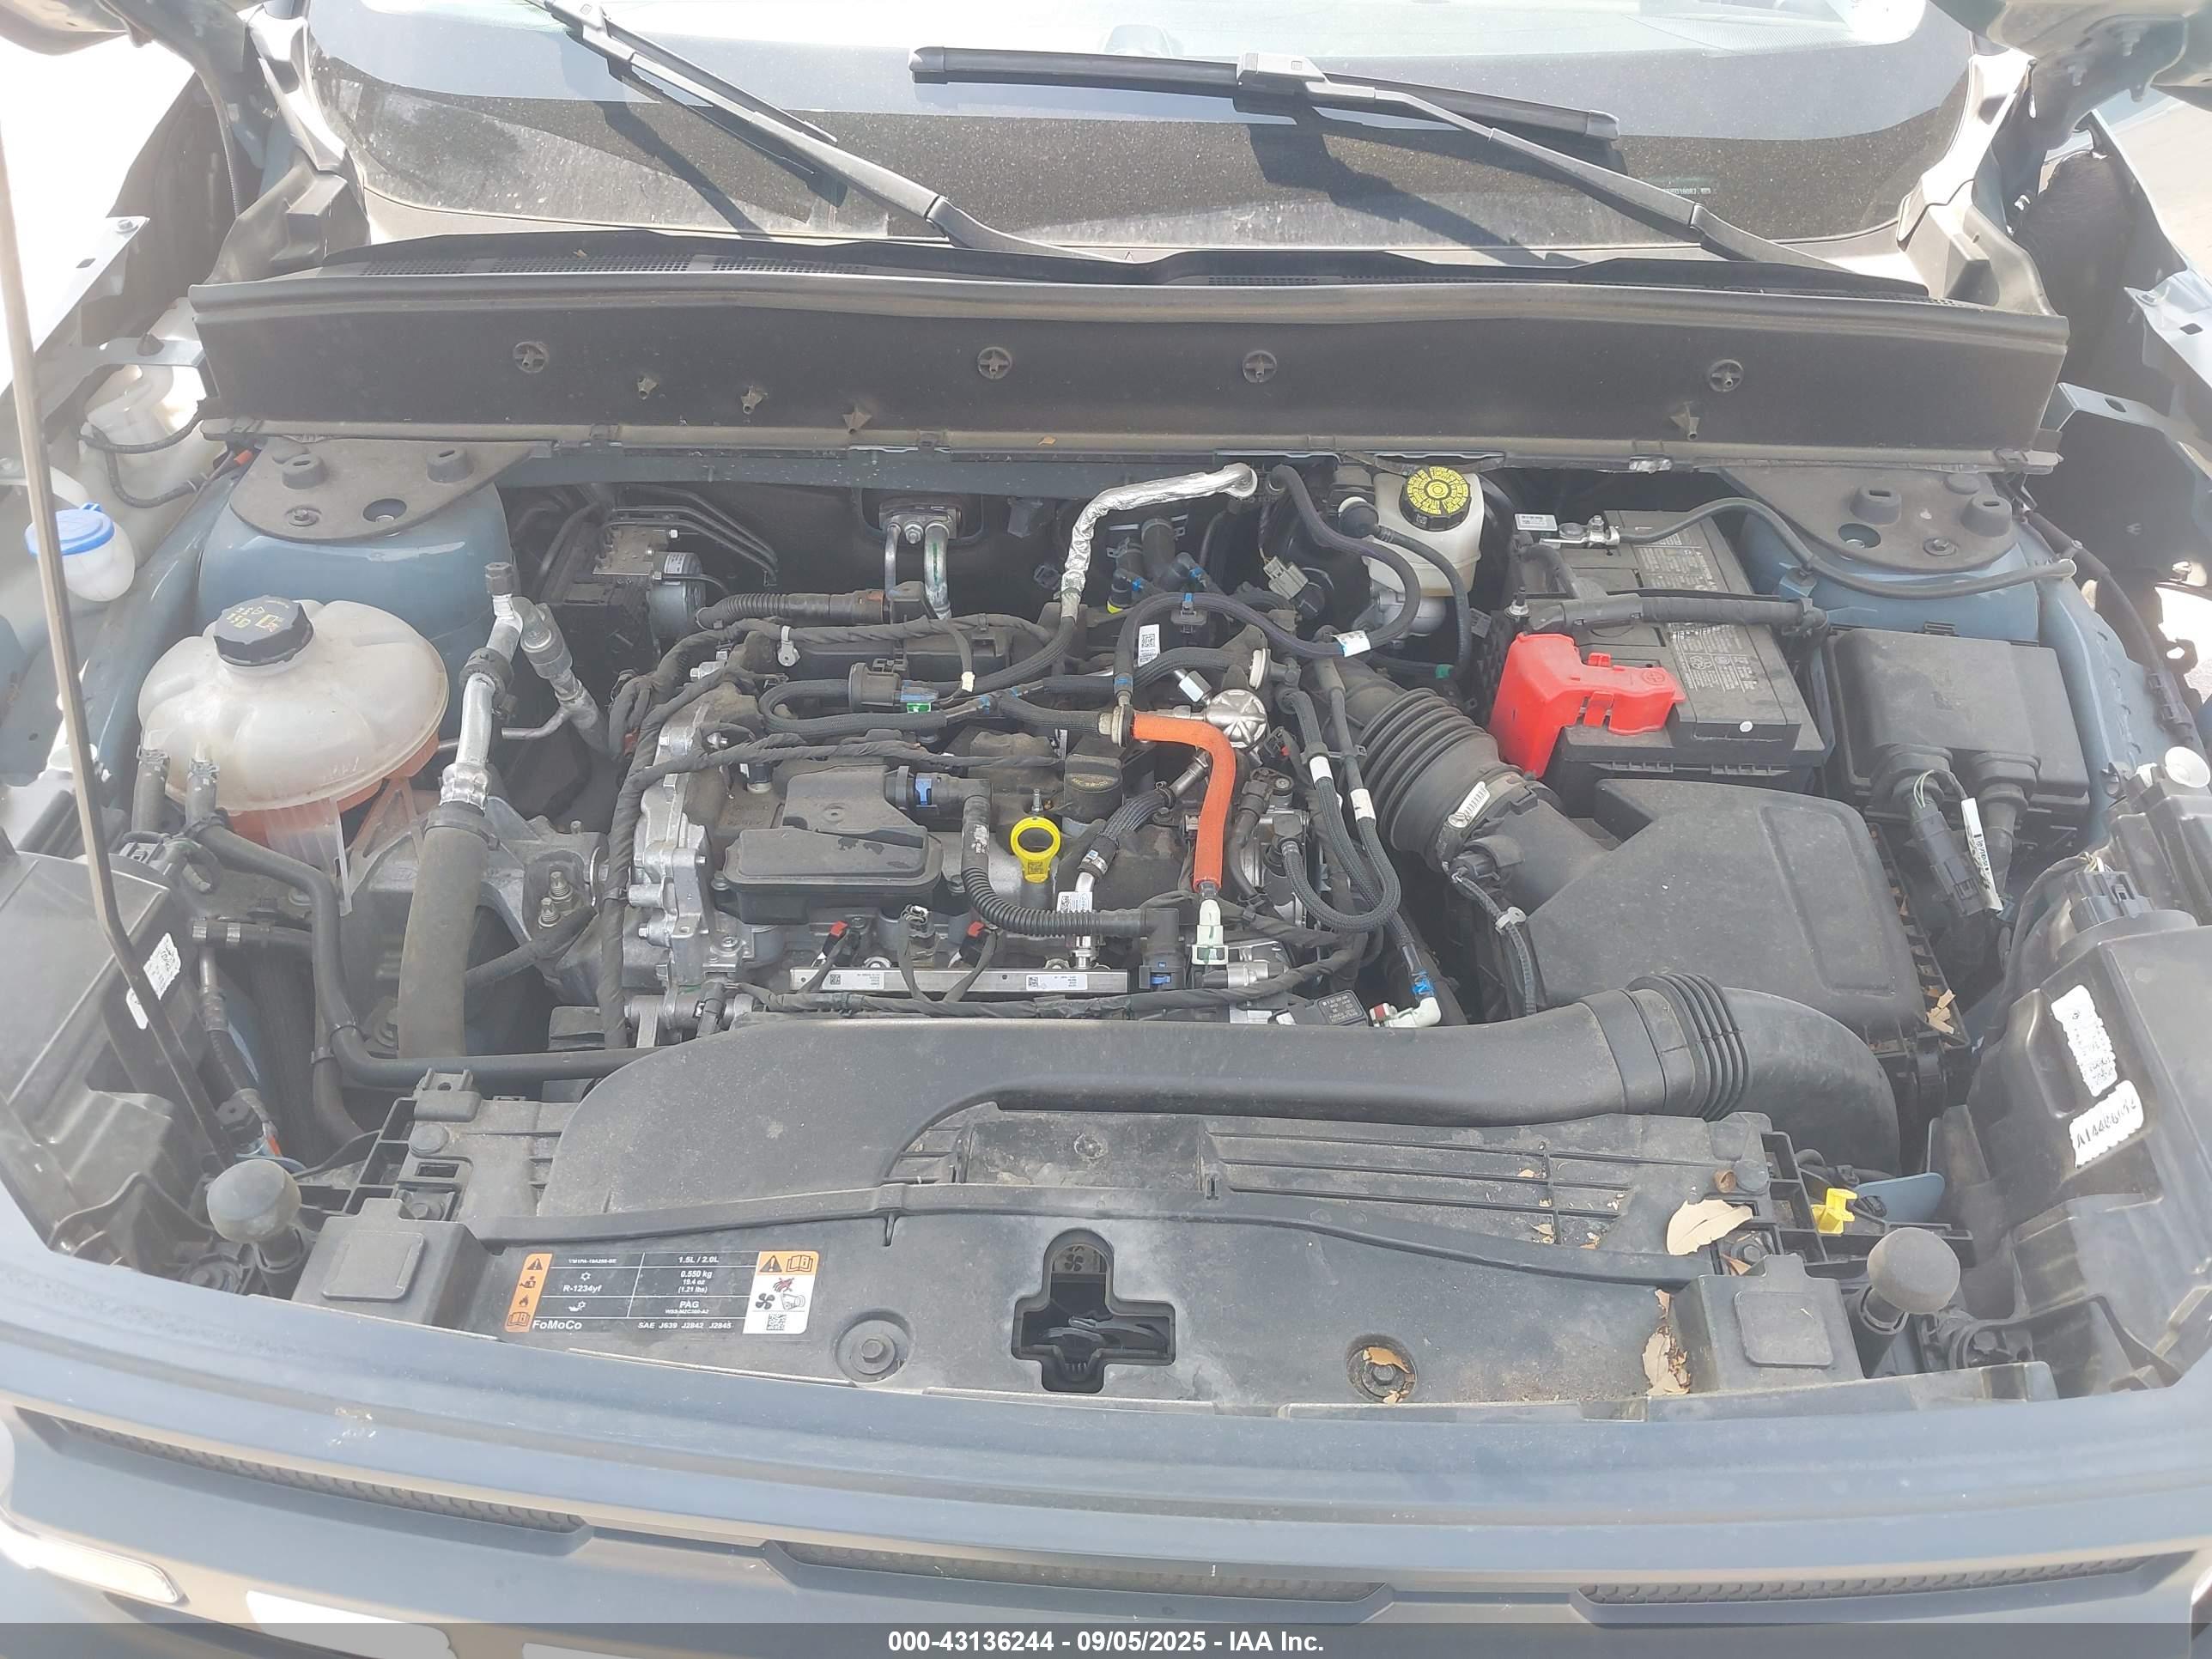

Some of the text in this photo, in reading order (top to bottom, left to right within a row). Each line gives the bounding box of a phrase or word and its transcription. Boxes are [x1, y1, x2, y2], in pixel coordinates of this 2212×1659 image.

[702, 1270, 713, 1279] kg
[562, 1285, 603, 1294] R-1234yf
[532, 1320, 582, 1329] FoMoCo
